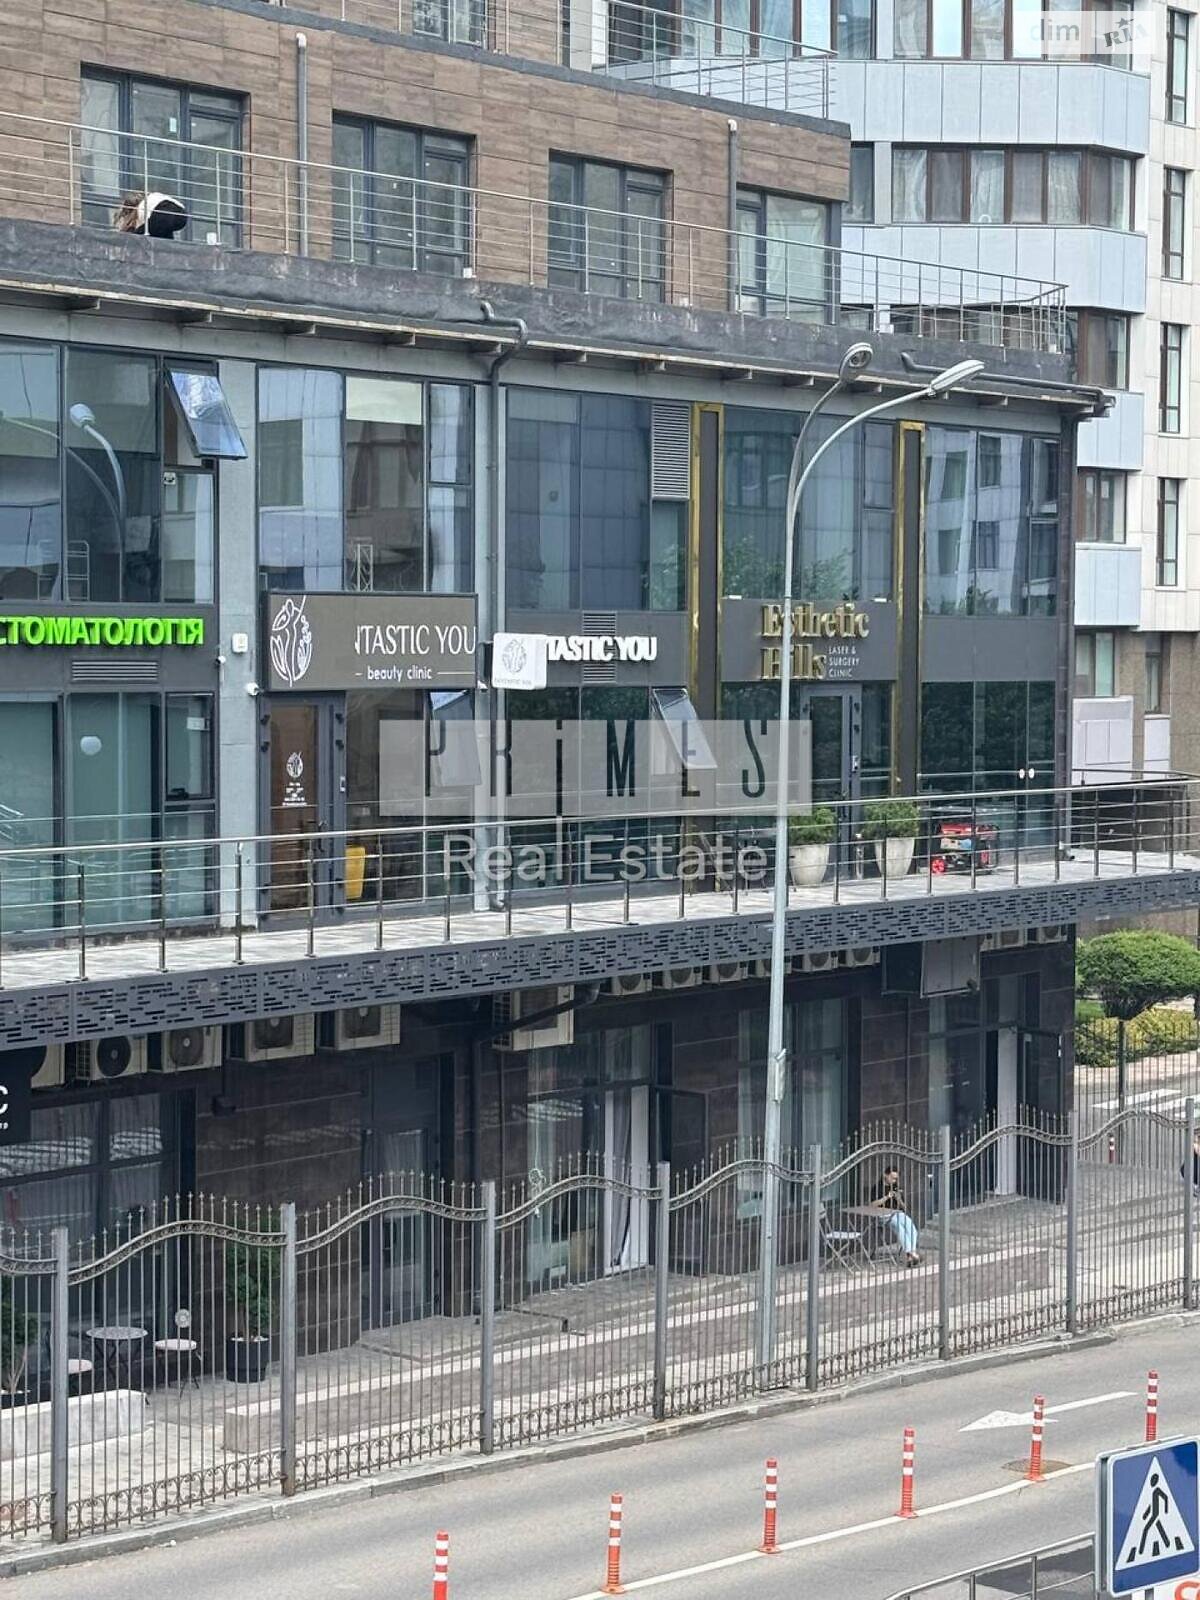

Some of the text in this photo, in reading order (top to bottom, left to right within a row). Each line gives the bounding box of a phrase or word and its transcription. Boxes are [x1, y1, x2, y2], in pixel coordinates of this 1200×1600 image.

[434, 624, 476, 655] YOU
[614, 636, 658, 661] YOU
[366, 664, 433, 682] beauty clinic
[761, 643, 827, 680] Hills
